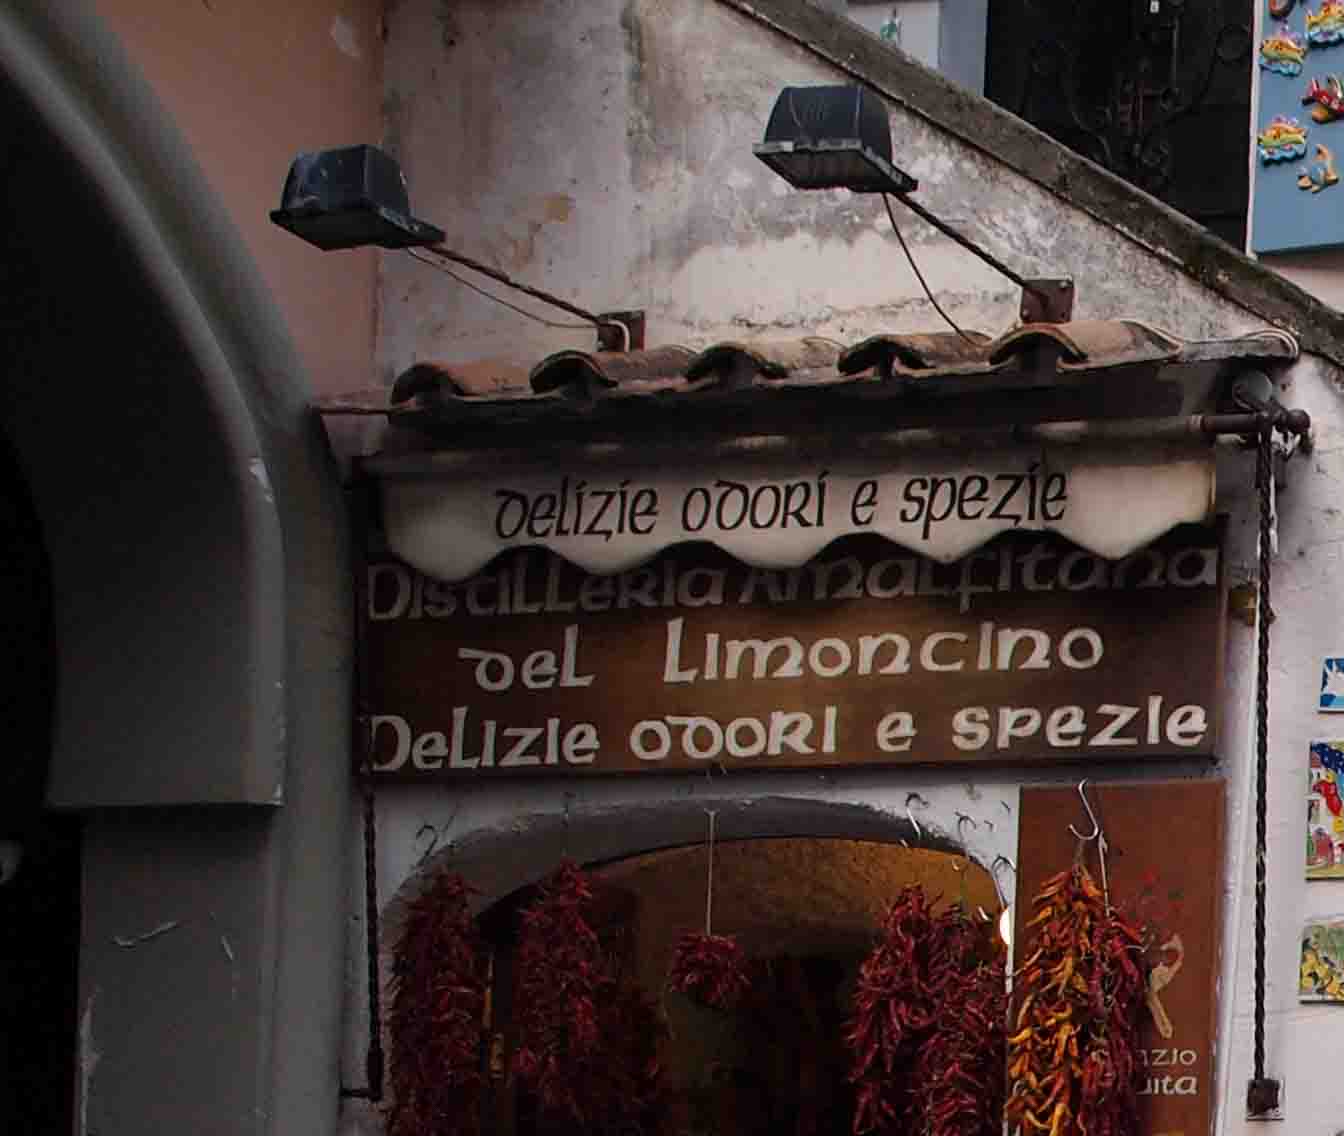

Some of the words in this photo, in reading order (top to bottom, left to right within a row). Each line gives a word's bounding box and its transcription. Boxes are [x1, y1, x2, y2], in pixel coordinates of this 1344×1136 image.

[495, 477, 658, 541] delizie
[851, 479, 879, 526] e
[901, 463, 1068, 540] spezie
[458, 624, 595, 692] del
[663, 617, 1104, 684] Limoncino
[370, 706, 600, 772] Delizie
[876, 711, 917, 753] e
[952, 696, 1208, 752] spezie
